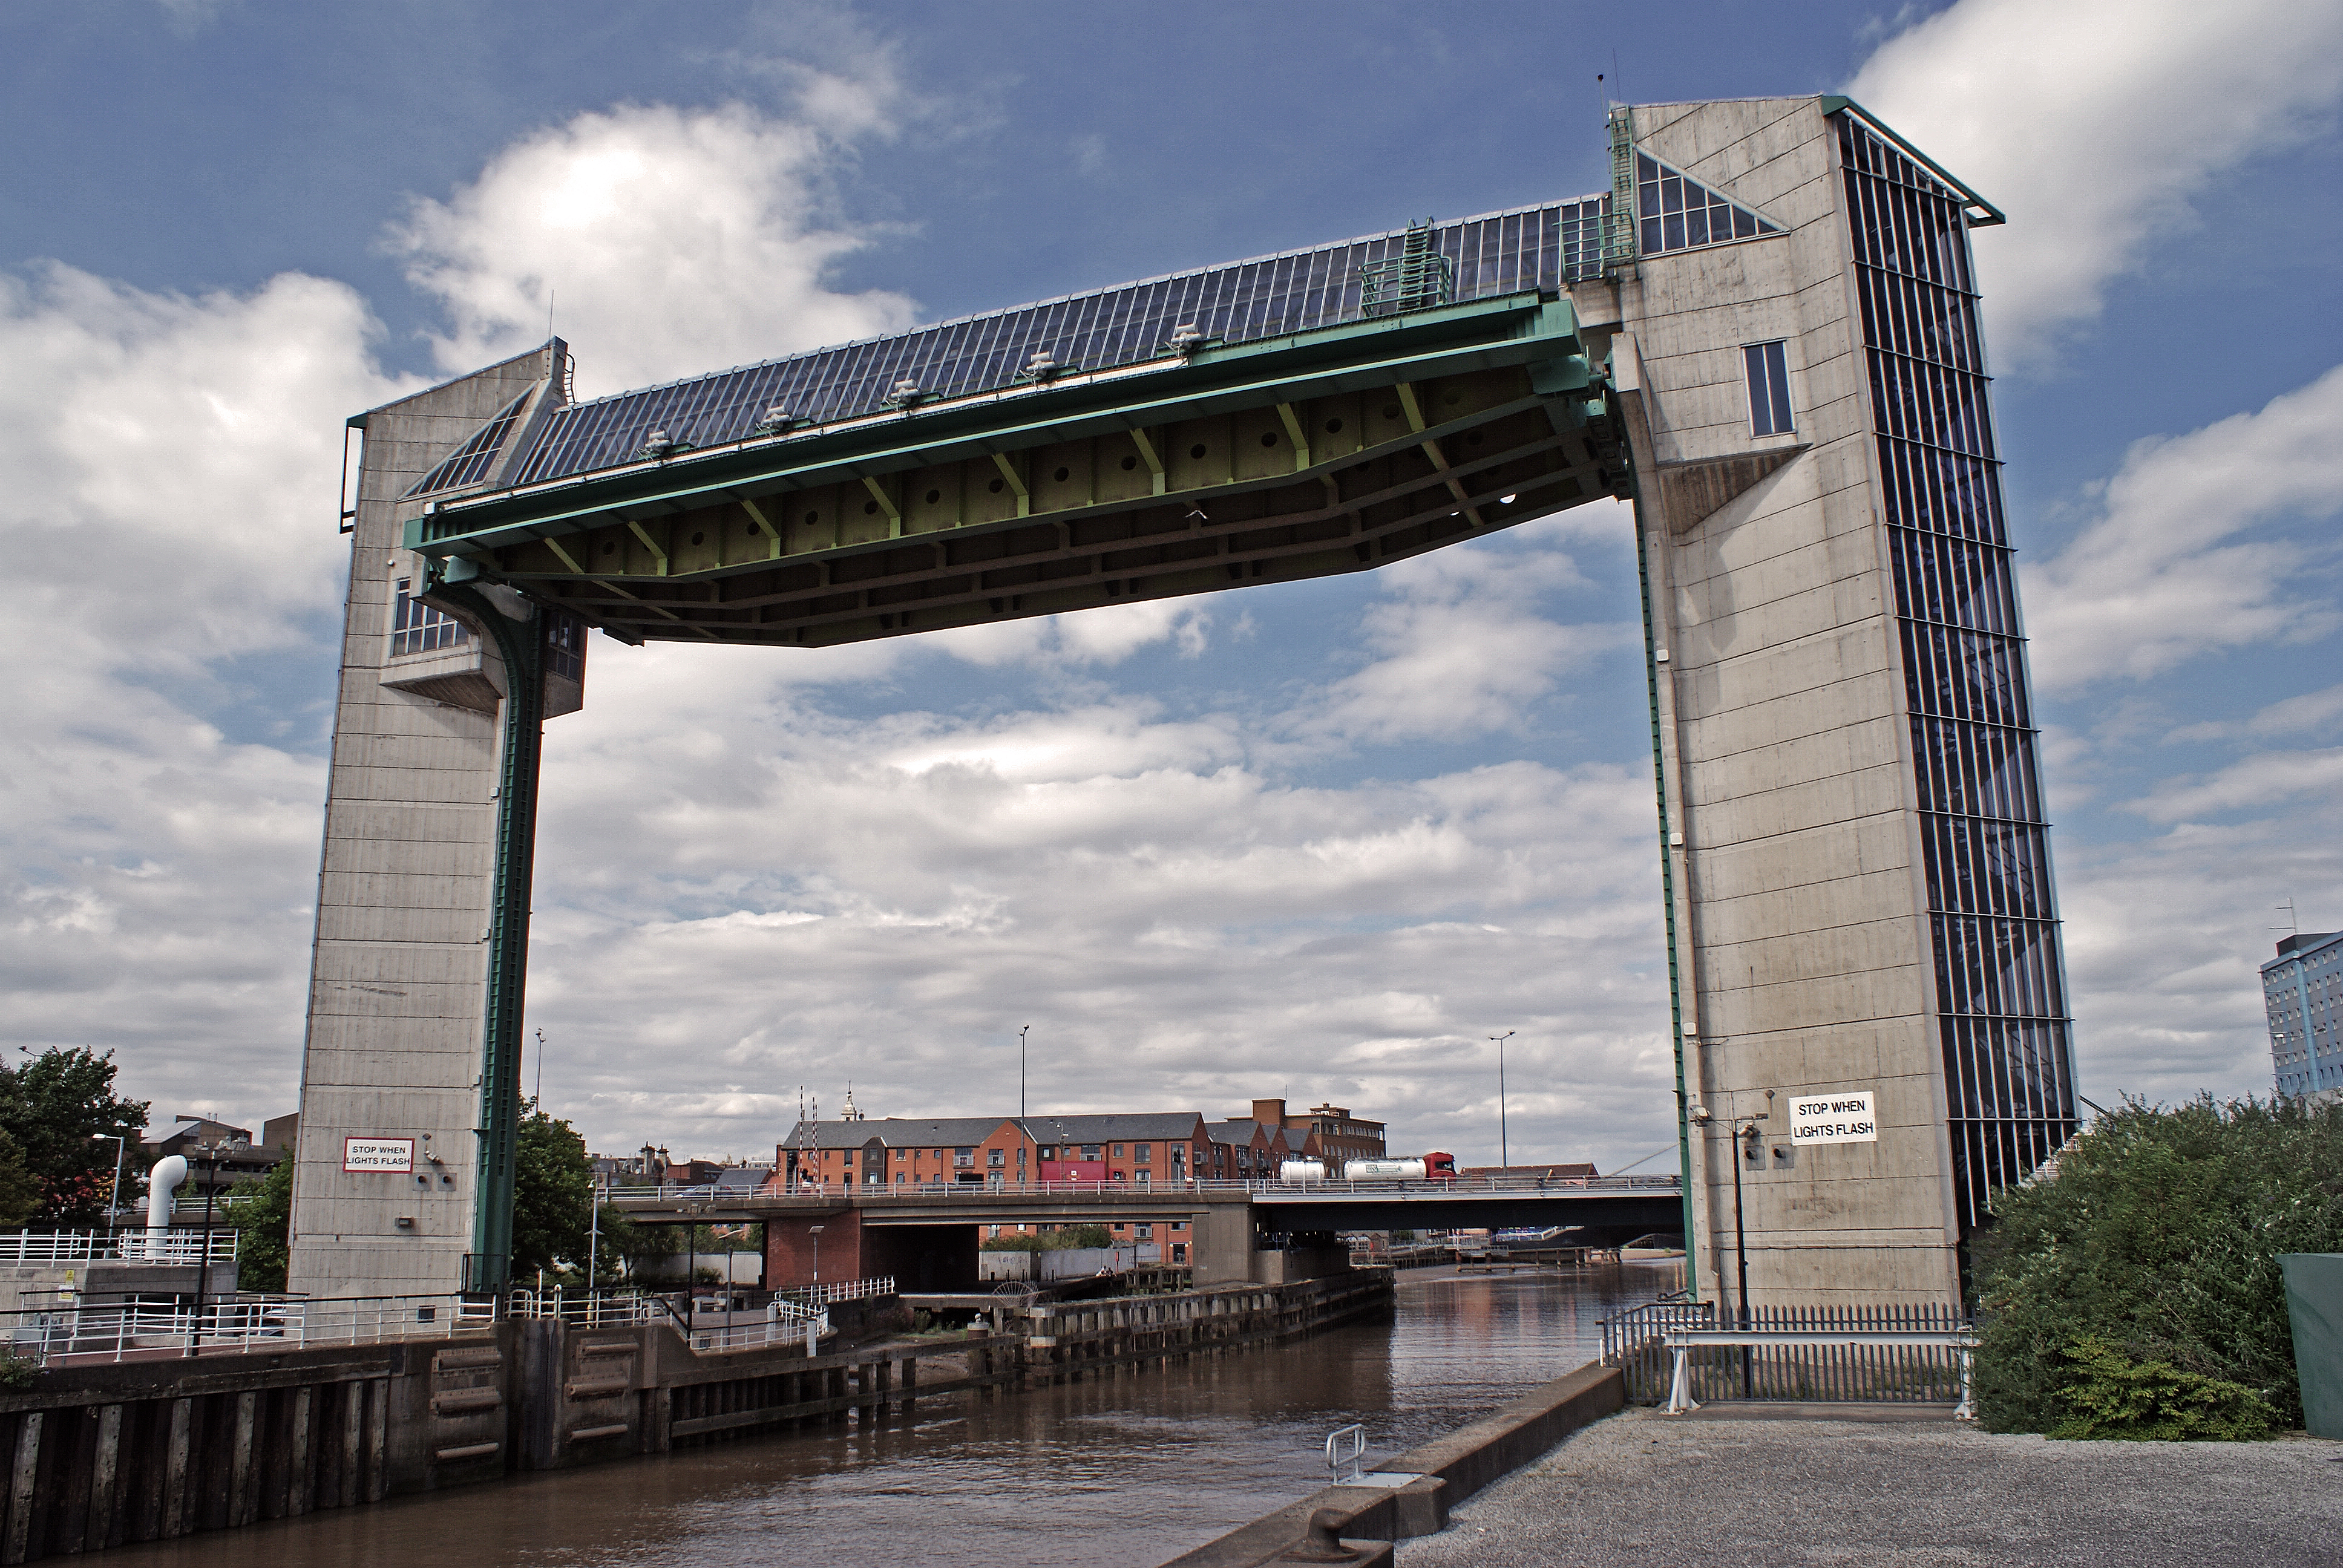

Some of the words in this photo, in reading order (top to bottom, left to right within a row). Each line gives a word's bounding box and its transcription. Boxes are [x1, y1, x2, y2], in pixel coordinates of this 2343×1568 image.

[1798, 1103, 1827, 1116] STOP
[1831, 1100, 1865, 1113] WHEN
[1794, 1125, 1833, 1138] LIGHTS
[1836, 1122, 1873, 1135] FLASH
